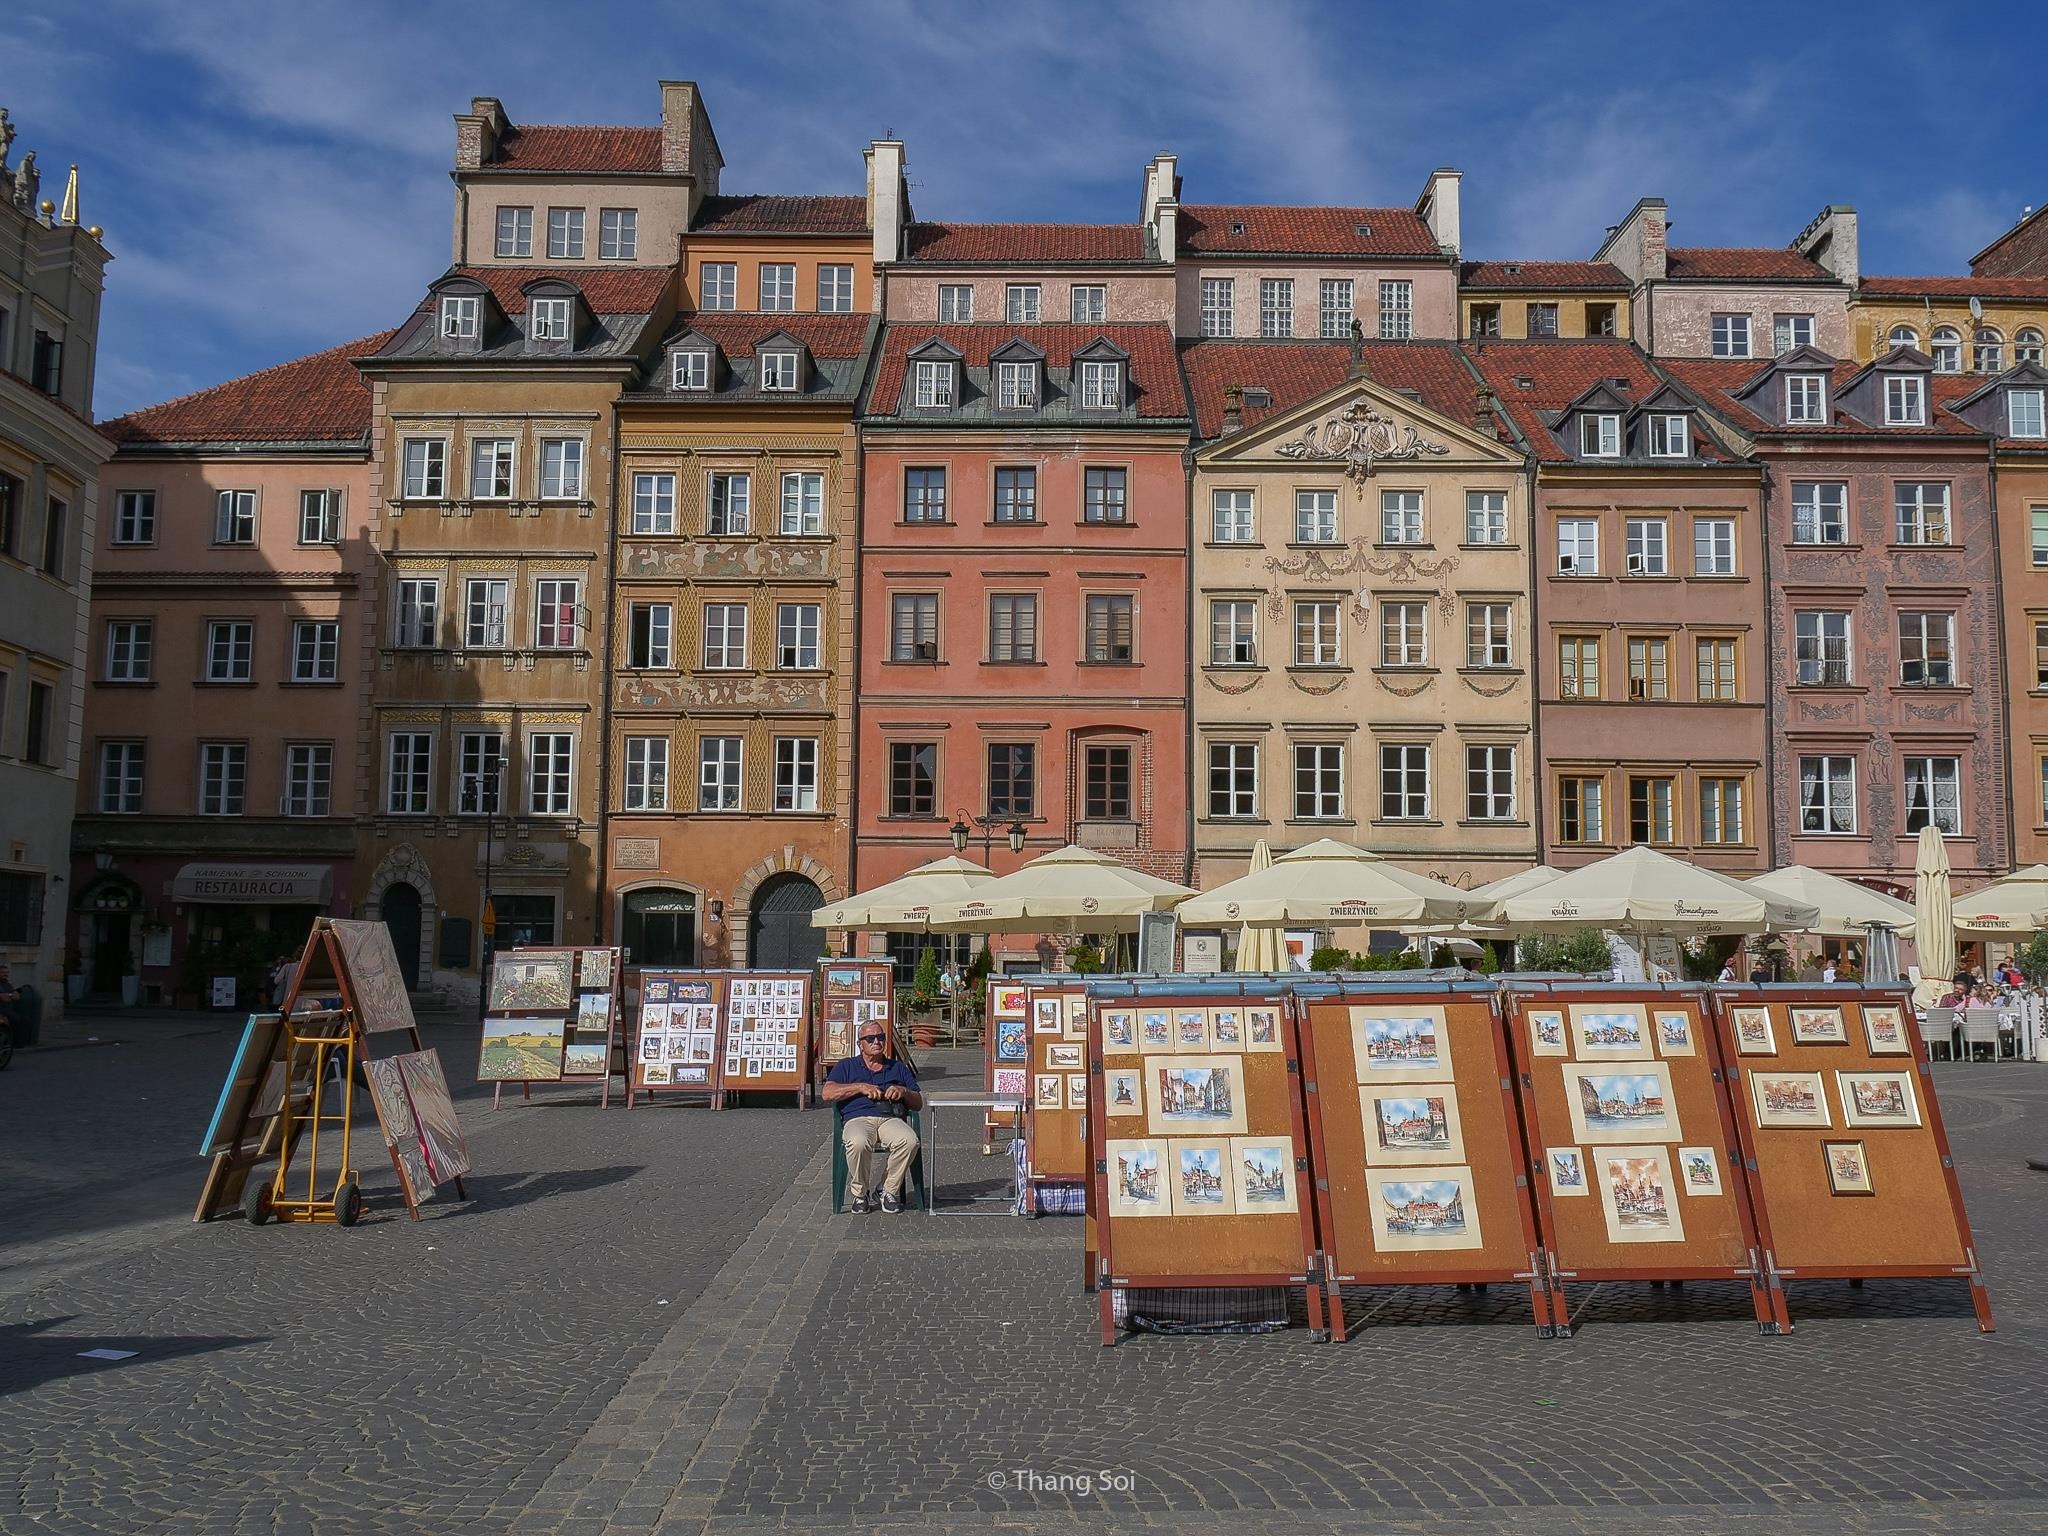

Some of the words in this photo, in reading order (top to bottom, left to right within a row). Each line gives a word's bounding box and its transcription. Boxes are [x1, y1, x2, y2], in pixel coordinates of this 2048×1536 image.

[195, 870, 246, 878] KAMIENNE
[195, 881, 294, 894] RESTAURACJA
[959, 908, 992, 917] ZWIERZYNIEC
[1330, 907, 1378, 915] ZWIERZYNIEC
[1966, 920, 2010, 928] ZWIERZYNIEC
